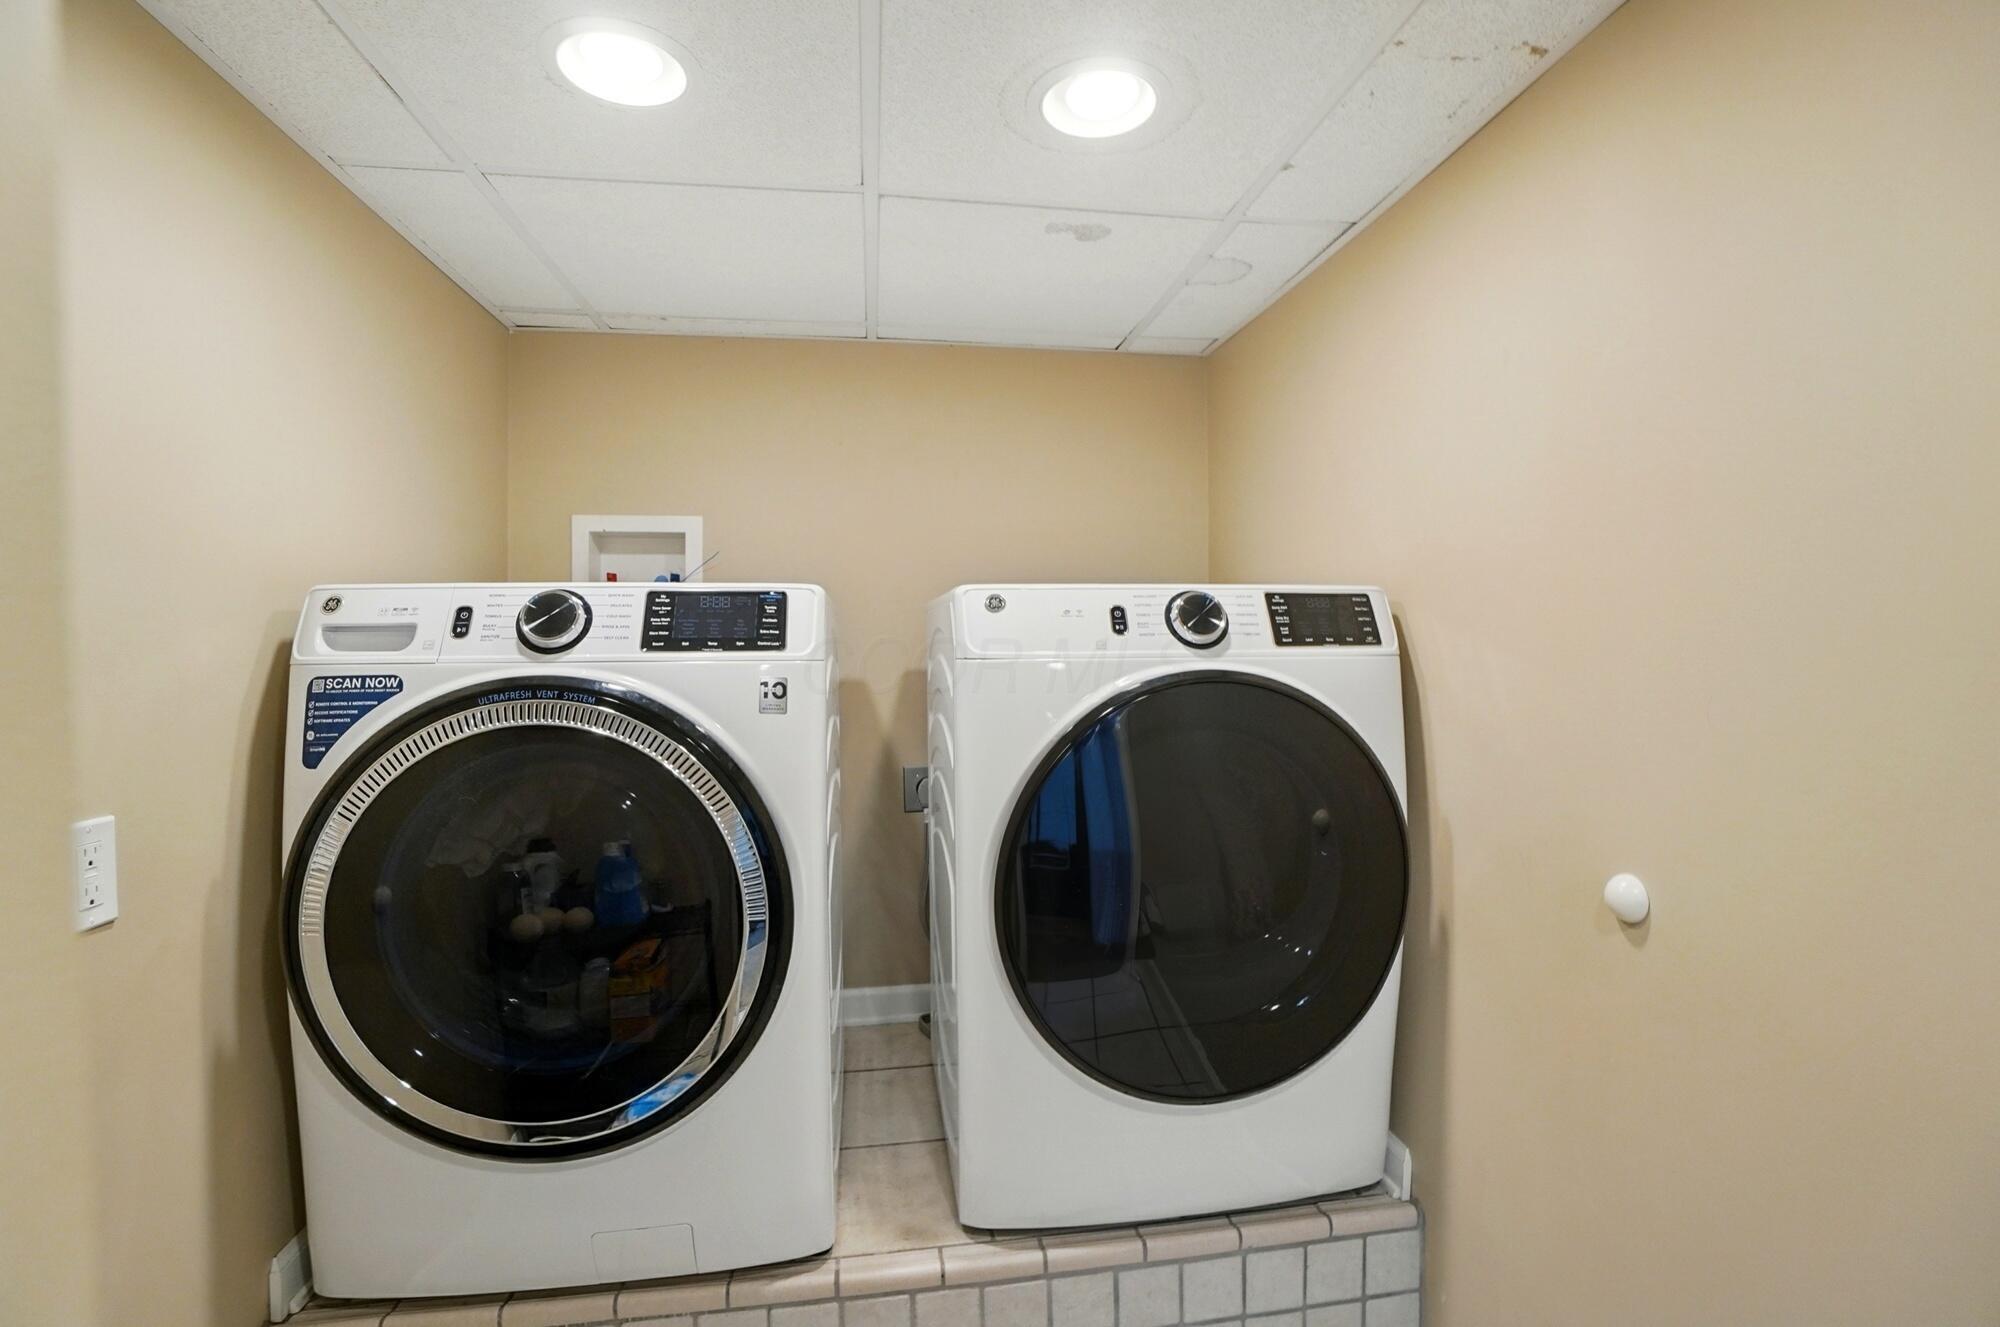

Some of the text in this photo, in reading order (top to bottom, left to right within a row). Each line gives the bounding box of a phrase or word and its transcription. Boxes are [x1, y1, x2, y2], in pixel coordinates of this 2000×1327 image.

[326, 677, 400, 689] SCAN NOW
[760, 681, 787, 700] 10
[478, 690, 596, 705] ULTRAFRESH VENT SYSTEM
